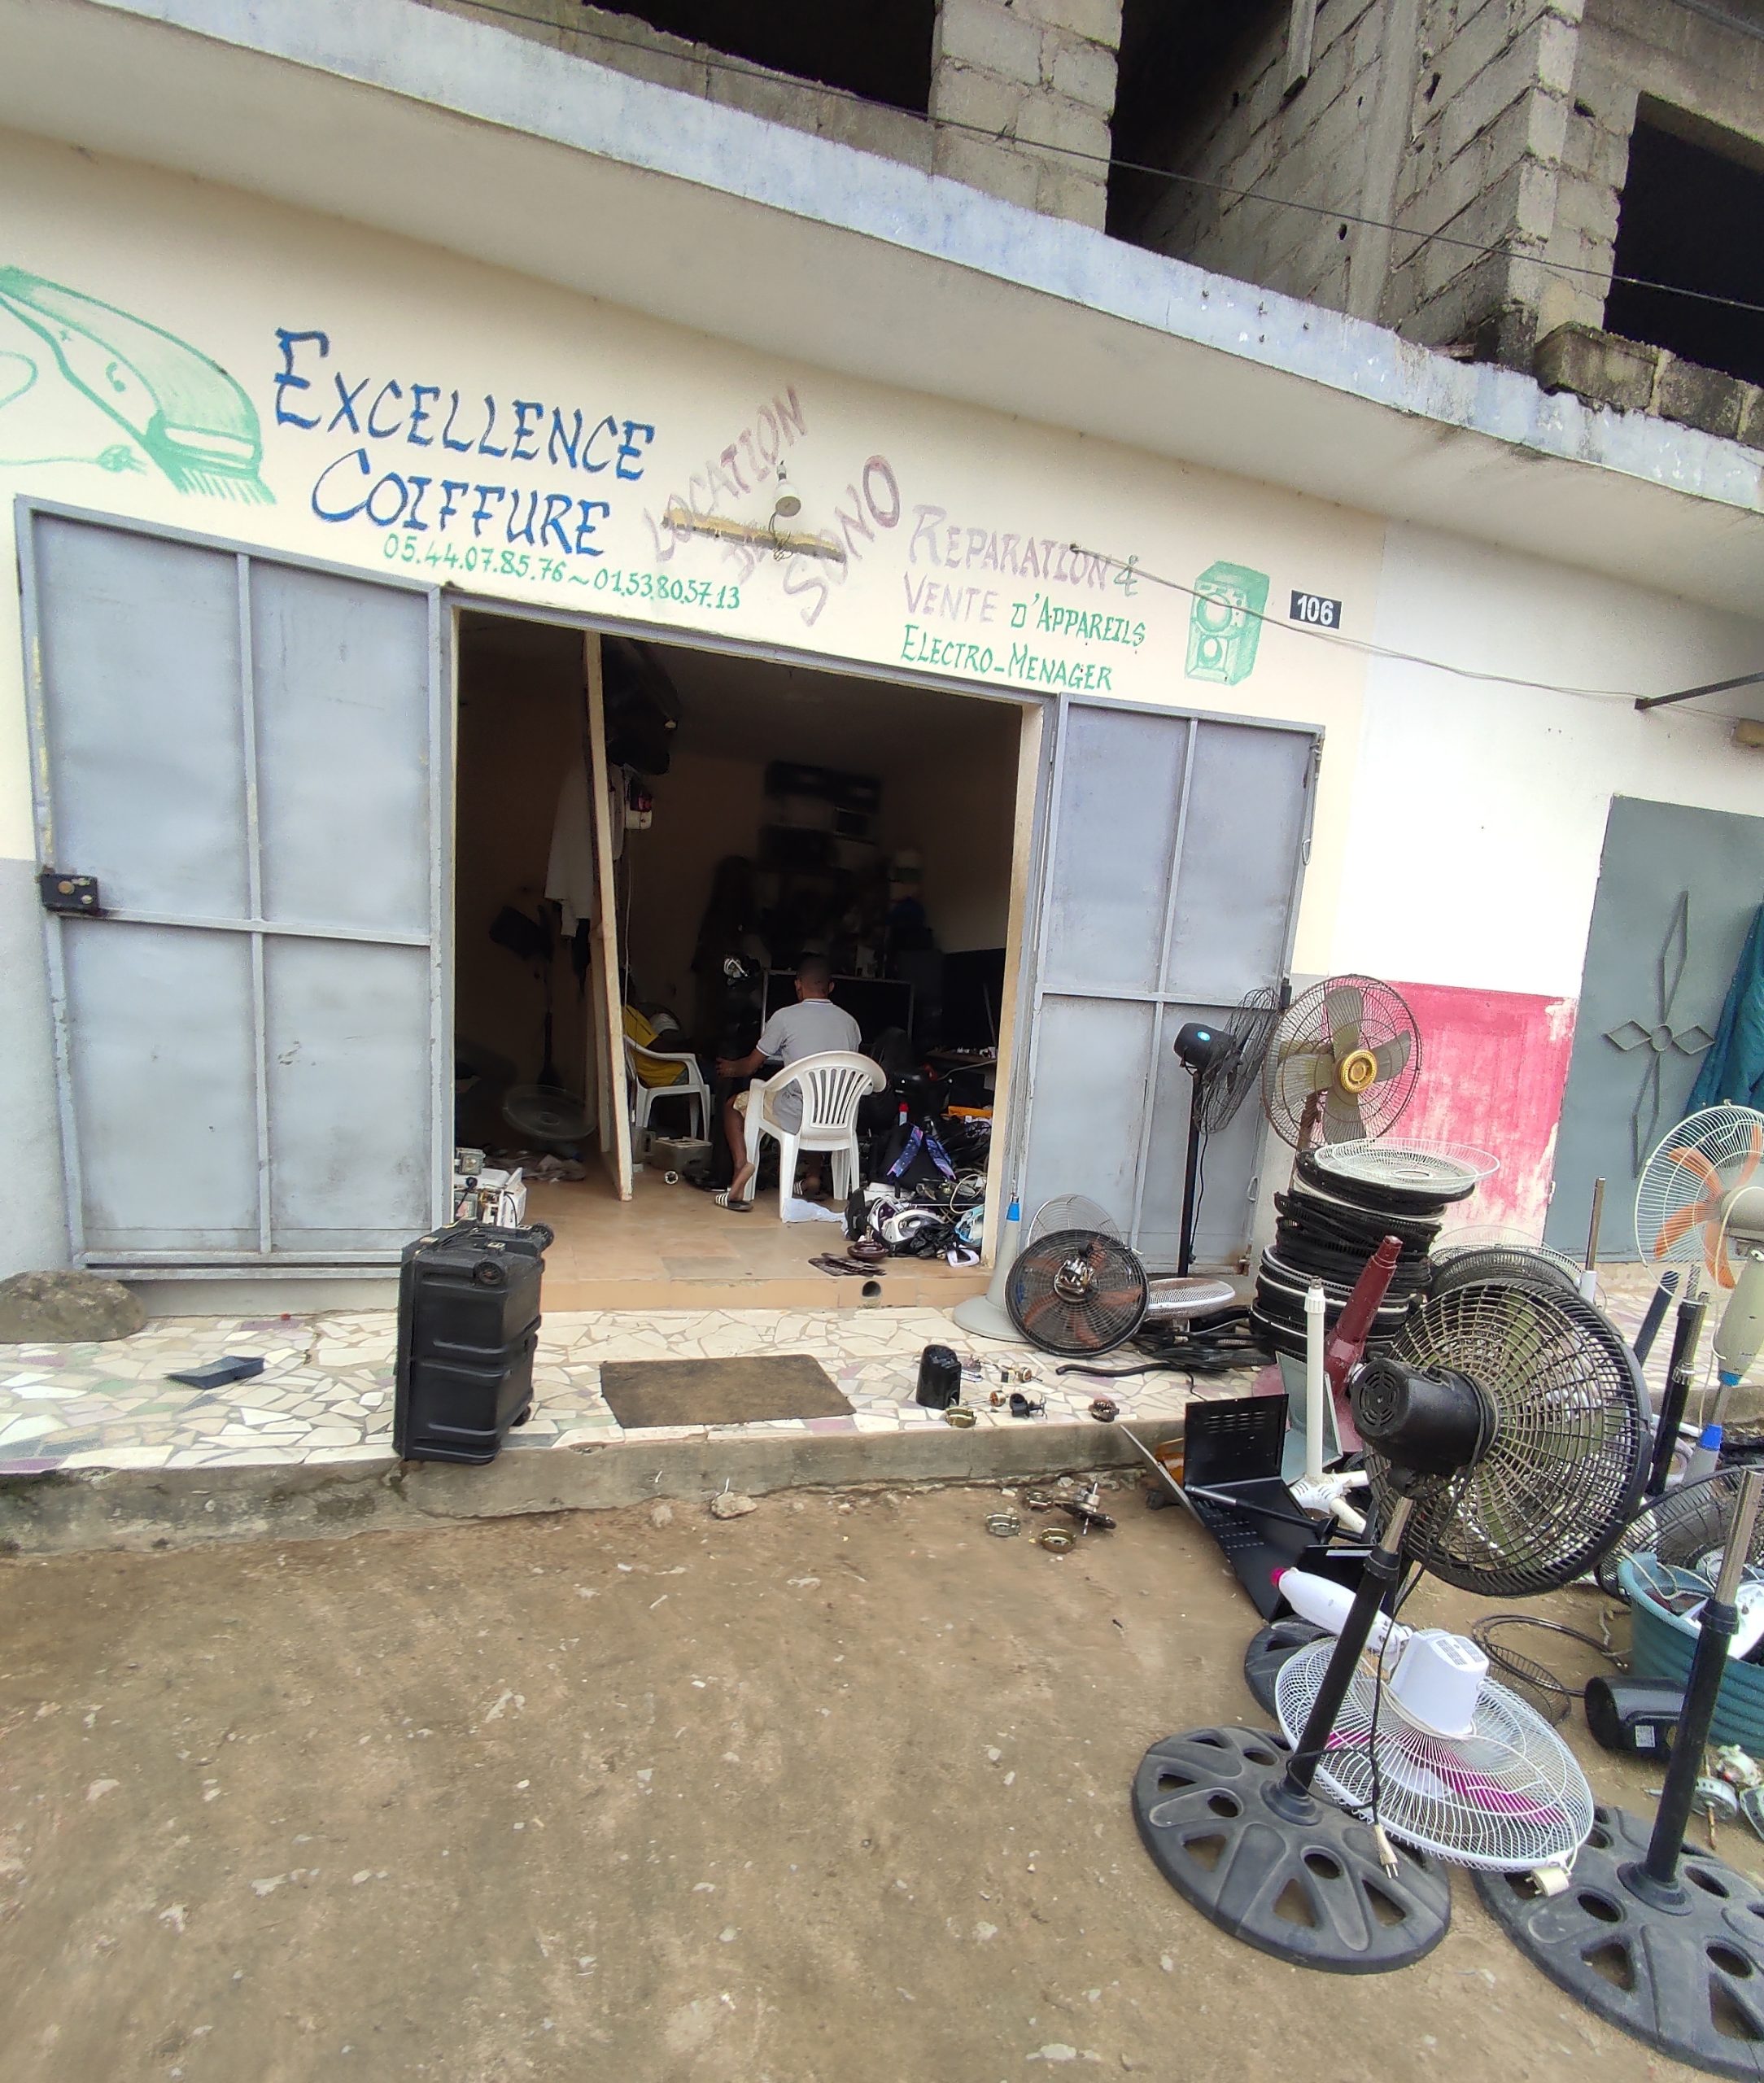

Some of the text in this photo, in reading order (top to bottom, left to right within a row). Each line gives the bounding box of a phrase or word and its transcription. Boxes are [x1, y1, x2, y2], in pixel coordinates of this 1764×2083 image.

[274, 327, 655, 482] EXCELLENCE
[311, 448, 611, 557] COIFFURE
[643, 385, 807, 562] LOCATION
[783, 455, 901, 627] SONO
[908, 504, 1112, 592] REPARATION
[903, 570, 1146, 648] VENTE D'APPAREILS
[1297, 594, 1334, 626] 106
